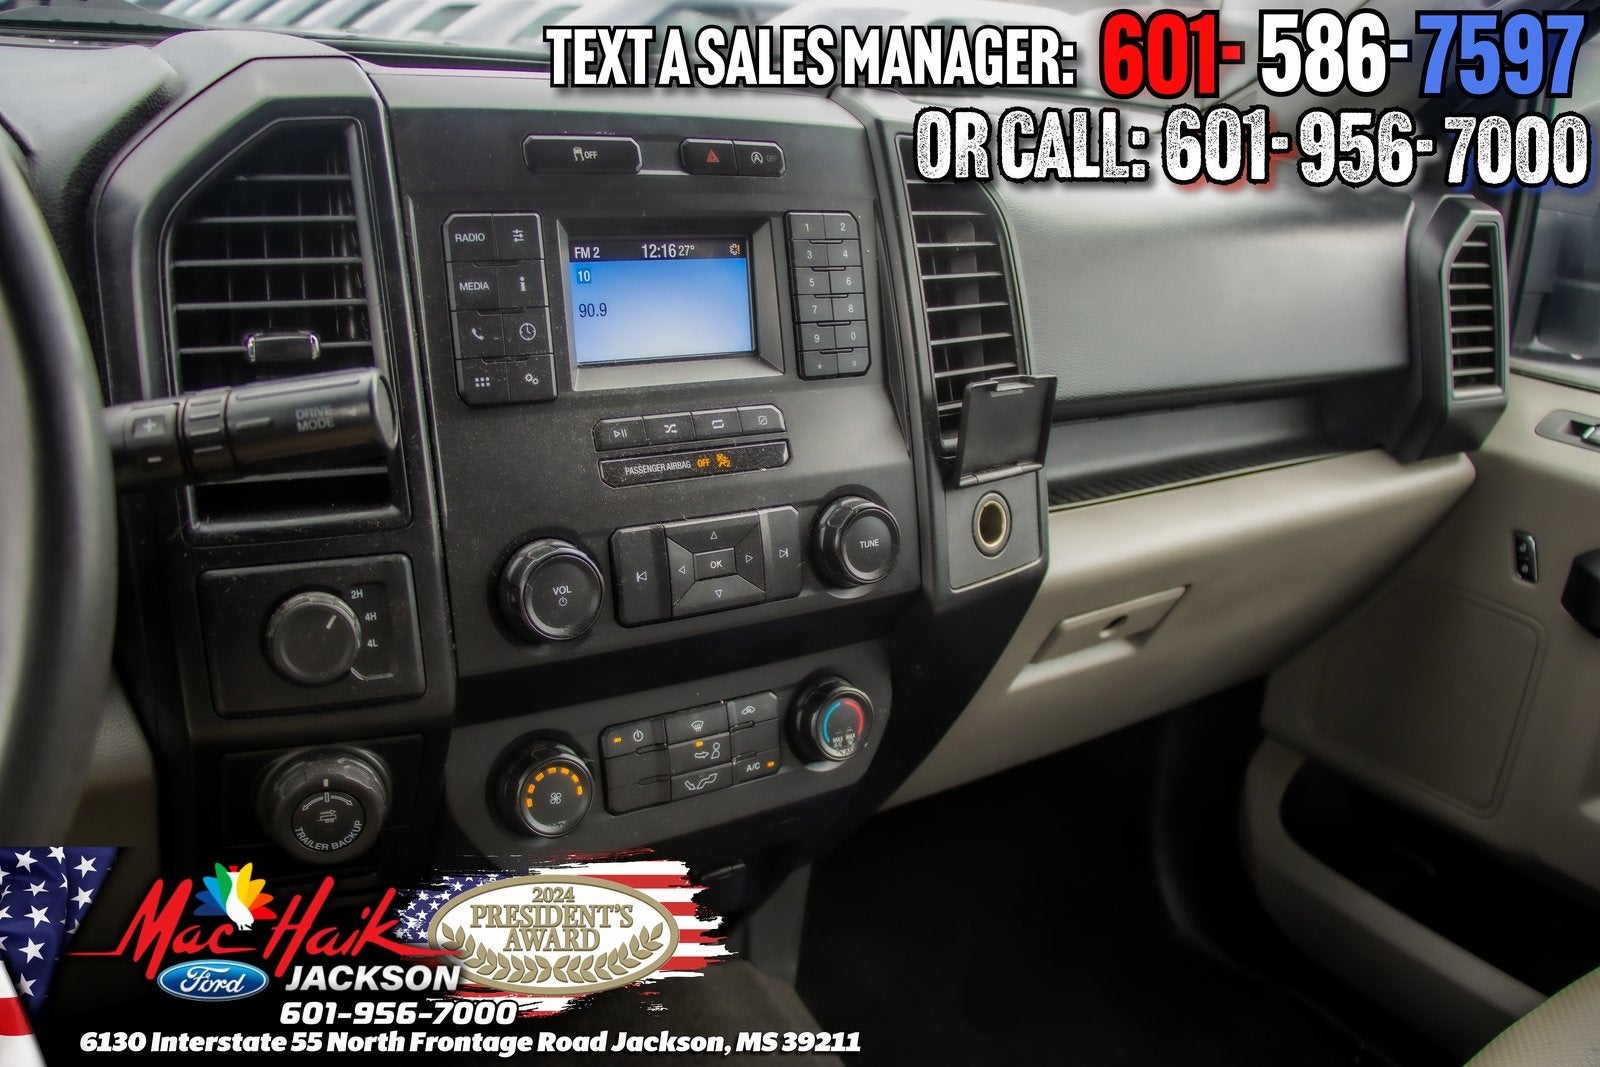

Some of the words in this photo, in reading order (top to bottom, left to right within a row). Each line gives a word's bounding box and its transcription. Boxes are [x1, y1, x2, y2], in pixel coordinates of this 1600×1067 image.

[584, 151, 598, 160] OFF
[803, 222, 811, 233] 1
[839, 221, 847, 232] 2
[454, 232, 486, 243] RADIO
[574, 245, 592, 259] FM
[593, 246, 601, 259] 2
[640, 243, 677, 259] 12:16
[678, 244, 696, 258] 27°
[805, 249, 814, 260] 3
[841, 248, 850, 259] 4
[576, 268, 592, 284] 10
[808, 277, 816, 288] 5
[844, 276, 852, 287] 6
[459, 281, 491, 292] MEDIA
[578, 302, 609, 319] 90.9
[810, 304, 818, 315] 7
[846, 303, 854, 314] 8
[812, 333, 820, 344] 9
[849, 331, 857, 342] 0
[295, 405, 333, 421] DRIVE
[297, 417, 335, 433] MODE
[624, 463, 666, 476] PASSENGER
[666, 459, 691, 472] AIRBAG
[697, 457, 710, 469] OFF
[859, 538, 880, 550] TUNE
[710, 560, 723, 570] OK
[351, 589, 363, 599] 2H
[552, 585, 573, 595] VOL
[364, 612, 377, 622] 4H
[367, 638, 378, 648] 4L
[746, 761, 761, 773] A/C
[294, 826, 329, 851] TRAILER
[331, 819, 363, 850] BACKUP
